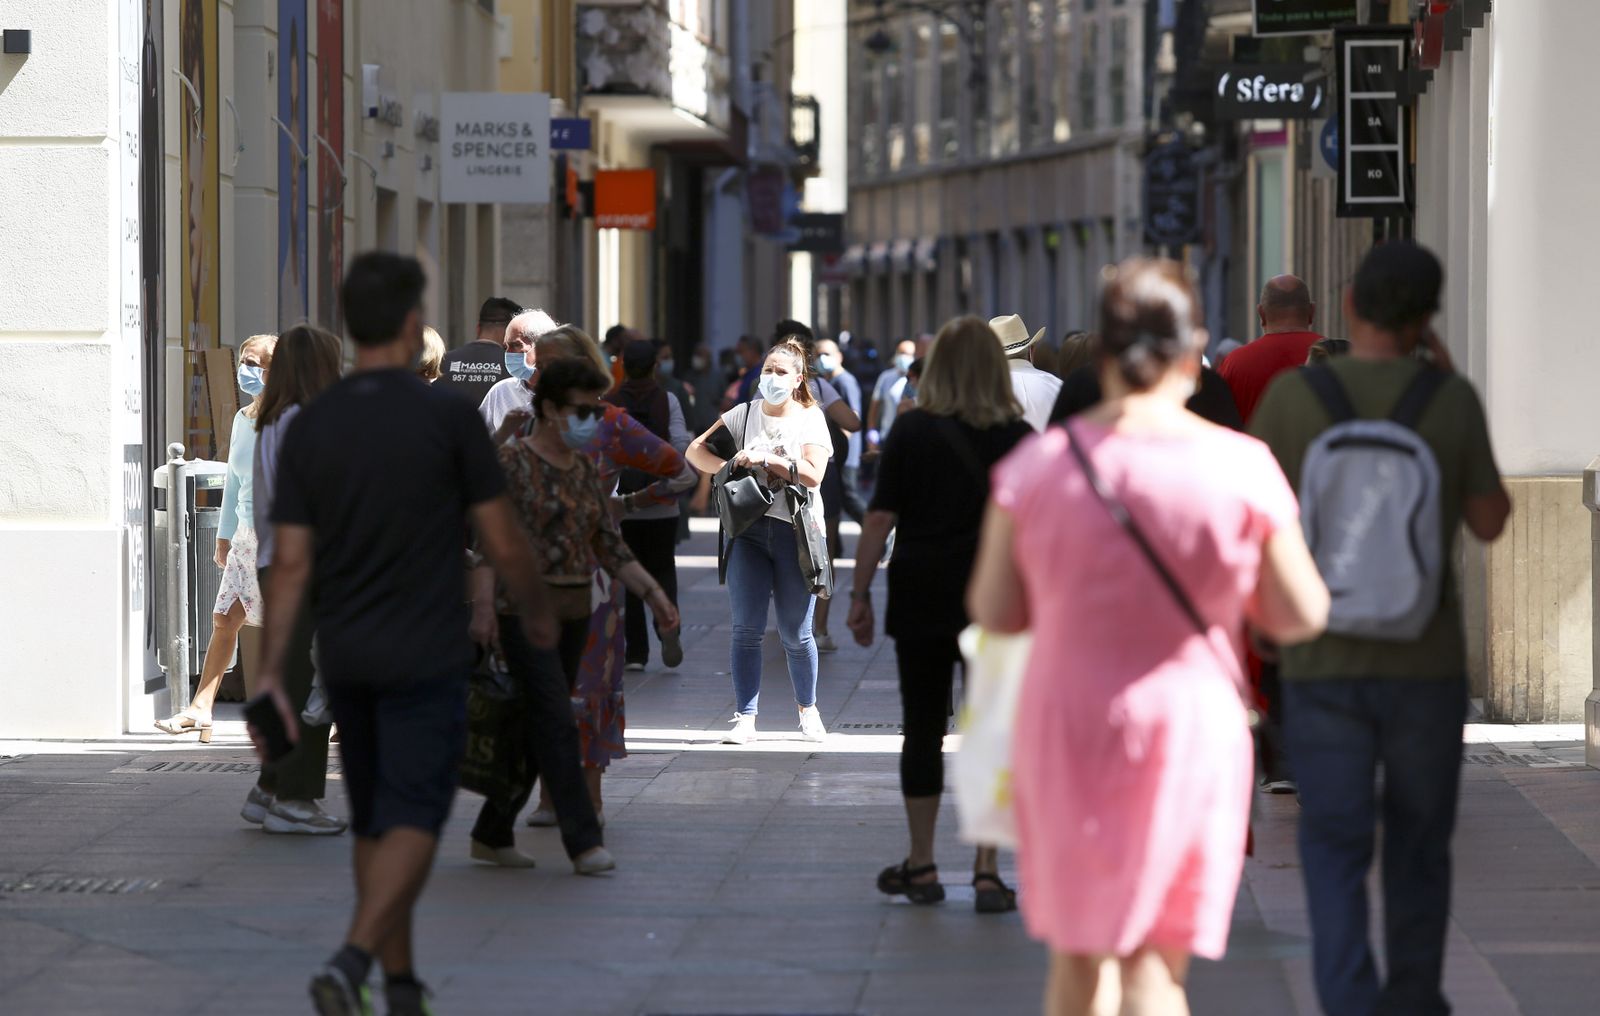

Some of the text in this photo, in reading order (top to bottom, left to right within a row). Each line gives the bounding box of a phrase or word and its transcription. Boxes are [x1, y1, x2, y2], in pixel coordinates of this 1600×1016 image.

[1286, 12, 1310, 22] para
[1313, 11, 1325, 20] tu
[1367, 64, 1382, 74] MI
[1367, 117, 1382, 127] SA
[455, 121, 517, 138] MARKS
[521, 122, 533, 137] &
[451, 142, 538, 158] SPENCER
[466, 164, 522, 176] LINGERIE
[1367, 169, 1382, 179] KO
[597, 213, 649, 227] orange
[452, 374, 467, 382] 957
[483, 375, 497, 383] 819
